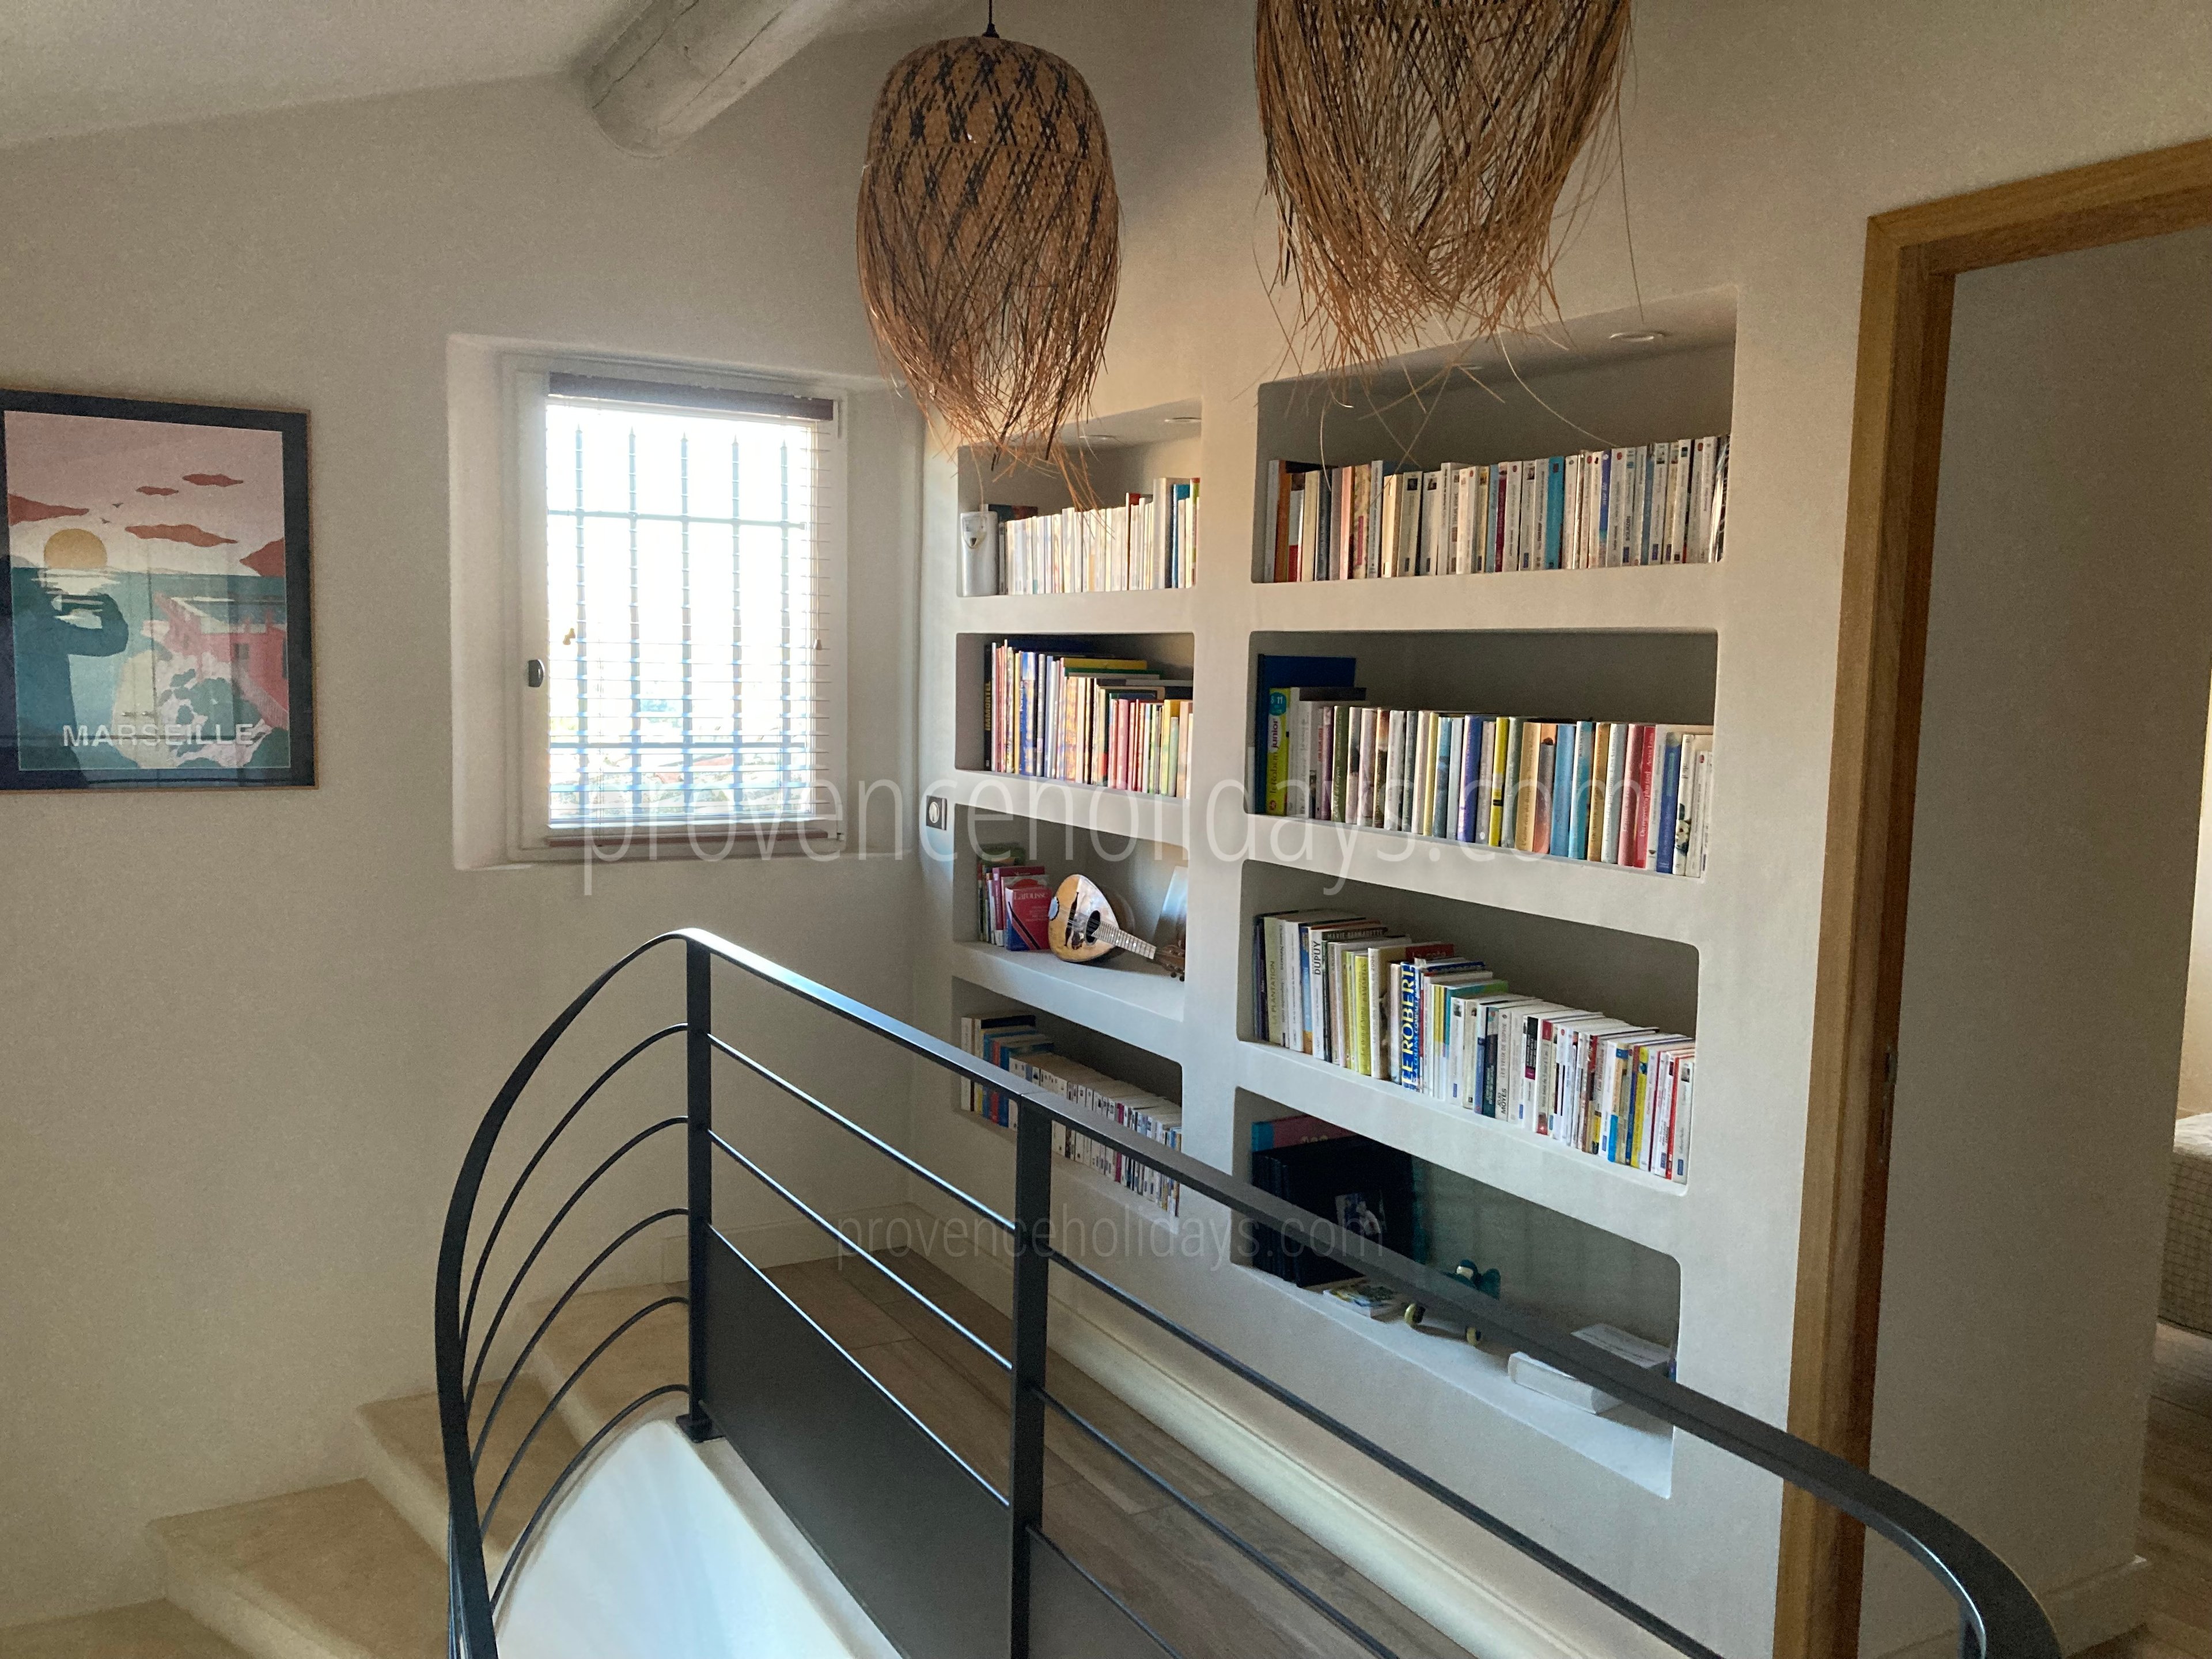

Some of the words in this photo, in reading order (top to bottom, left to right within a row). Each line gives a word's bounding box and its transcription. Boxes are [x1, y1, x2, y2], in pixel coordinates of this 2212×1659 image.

[63, 724, 254, 747] MARSEILLE
[1013, 892, 1046, 900] Larousse
[1313, 941, 1321, 975] DUPUY
[1401, 967, 1415, 1055] ROBERT
[1401, 1060, 1414, 1085] LE
